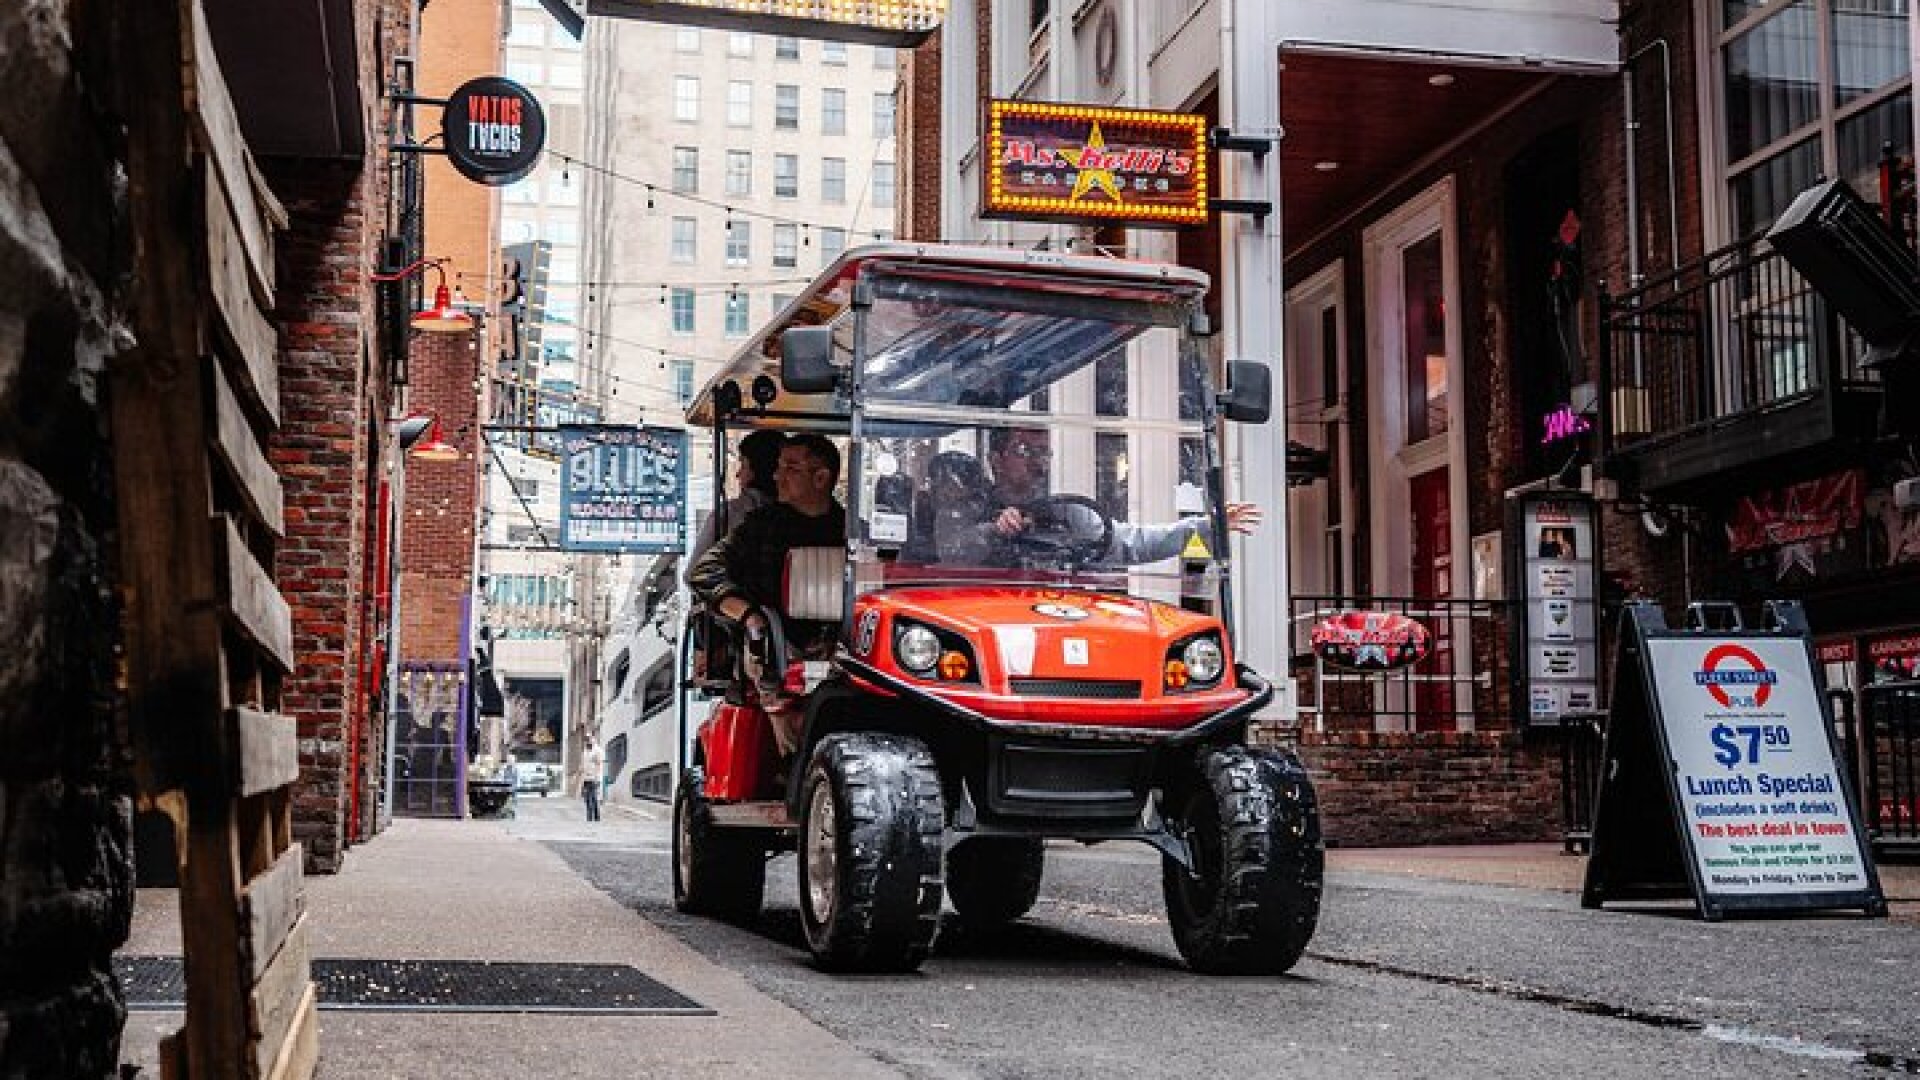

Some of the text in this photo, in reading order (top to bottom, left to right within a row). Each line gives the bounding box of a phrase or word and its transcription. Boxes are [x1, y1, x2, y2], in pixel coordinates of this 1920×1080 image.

[570, 447, 677, 494] BLUES
[1685, 773, 1834, 798] Lunch Special
[1695, 802, 1756, 818] (includes
[1771, 802, 1797, 814] soft
[1799, 801, 1838, 816] drink)
[1697, 821, 1848, 837] The best deal in town
